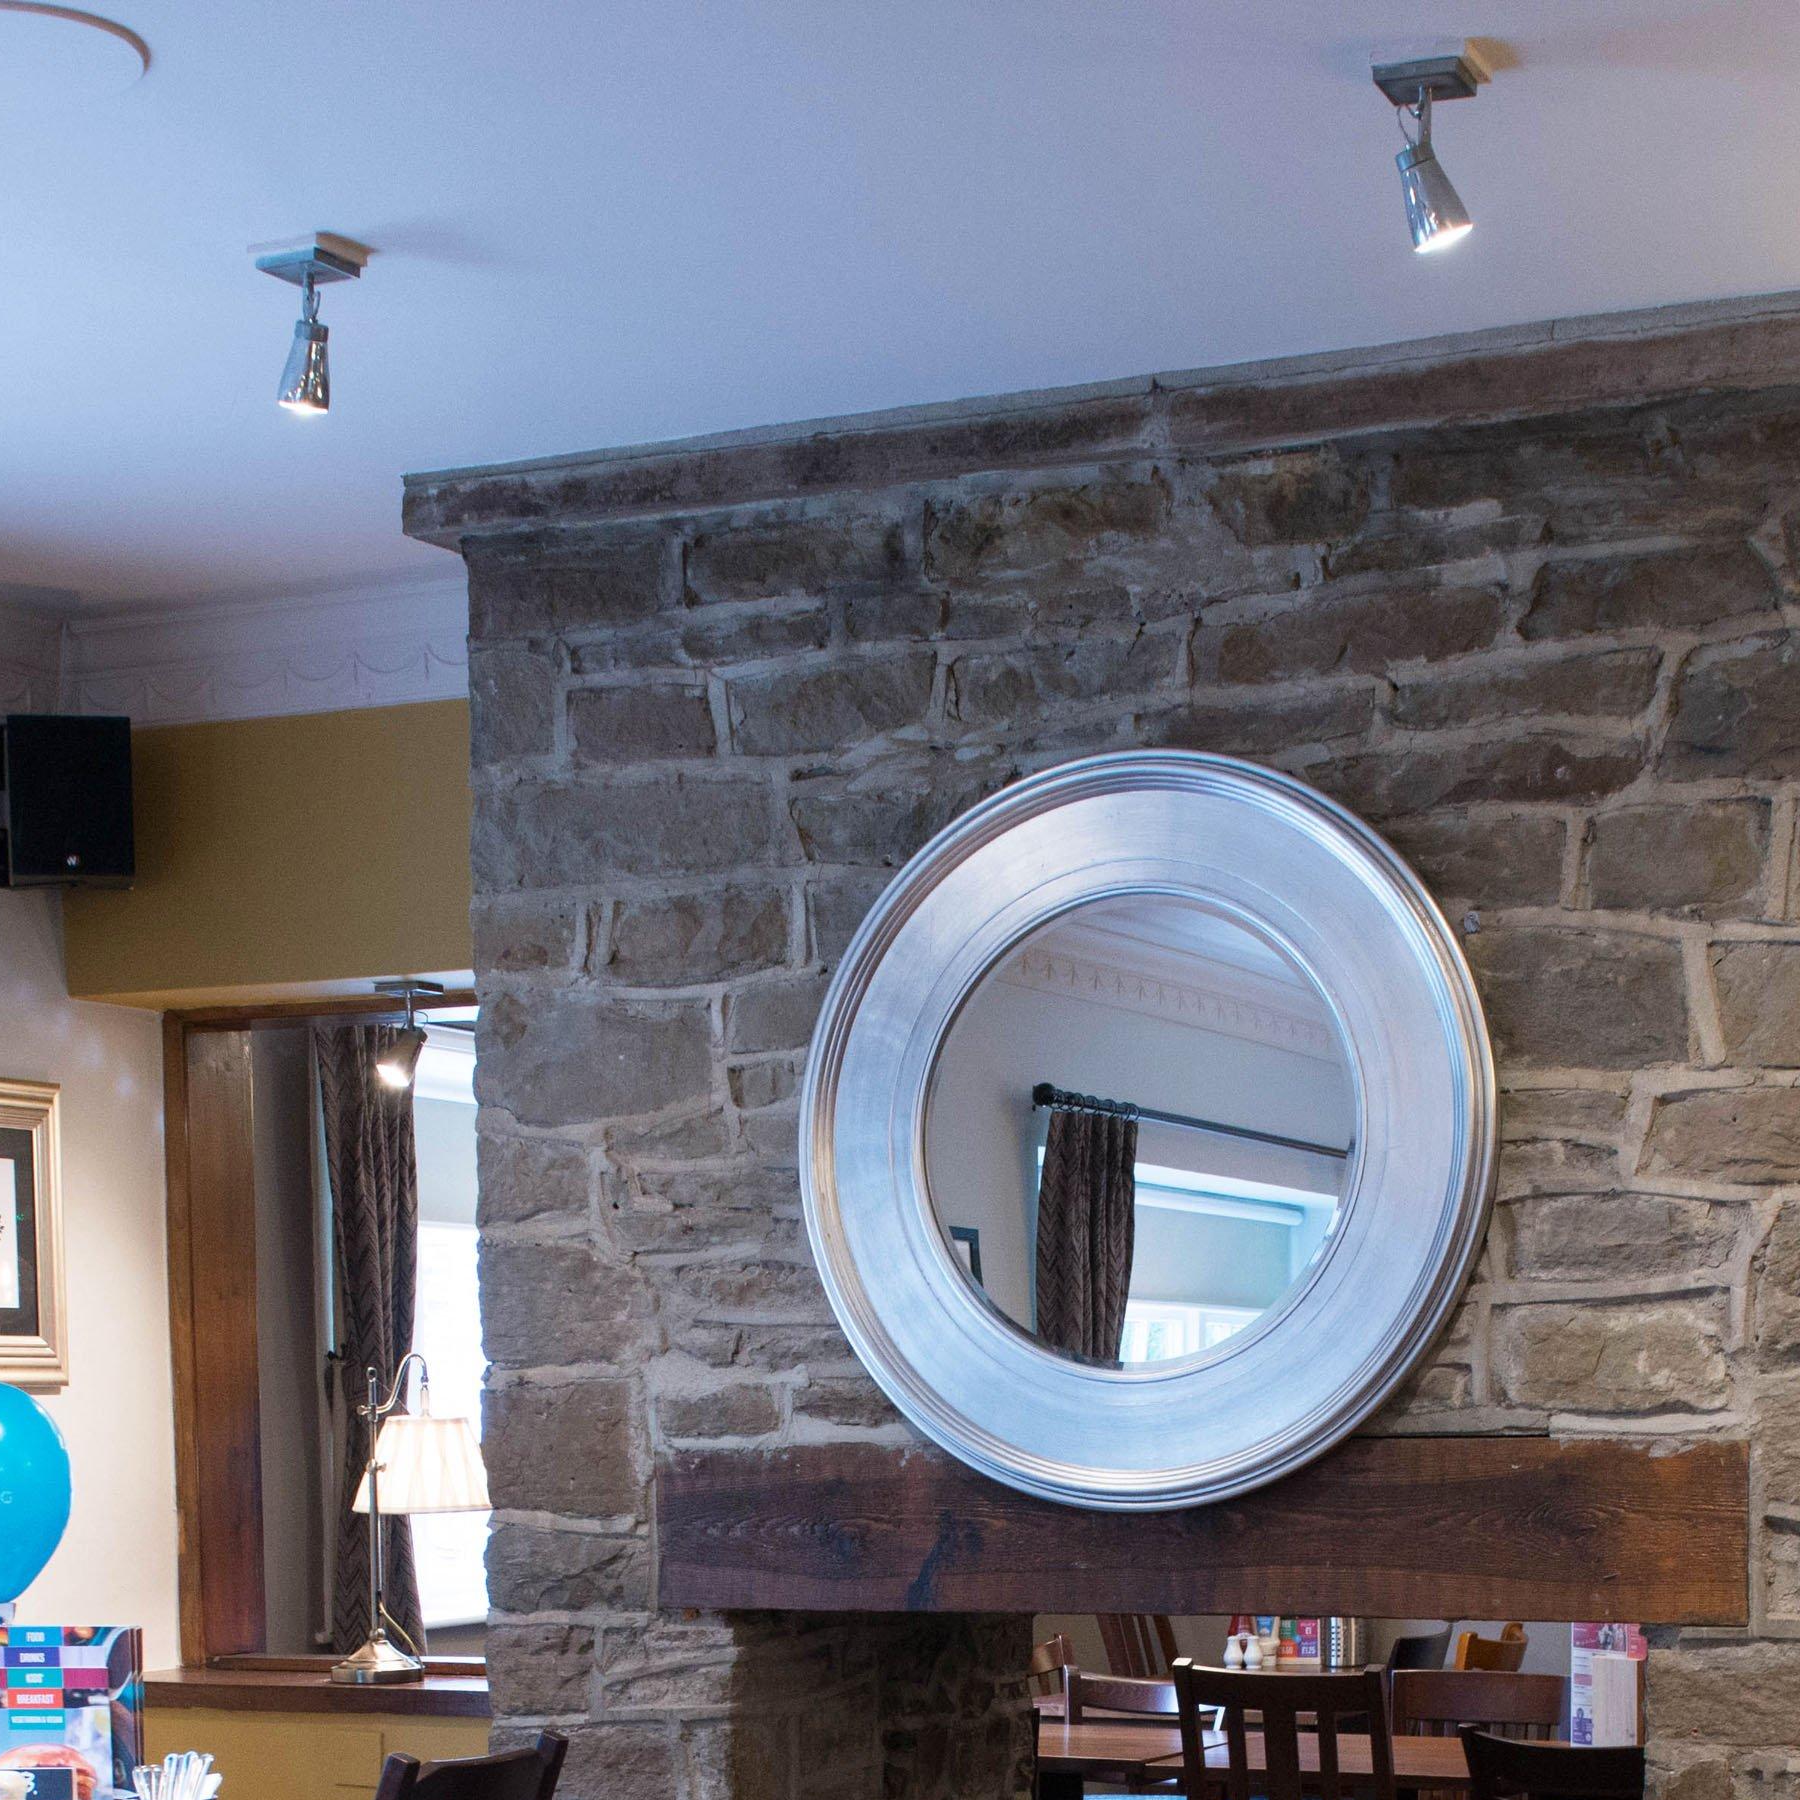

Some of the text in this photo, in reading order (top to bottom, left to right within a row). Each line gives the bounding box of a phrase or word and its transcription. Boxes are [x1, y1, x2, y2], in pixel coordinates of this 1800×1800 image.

[25, 1631, 45, 1643] FOOD
[19, 1652, 45, 1664] DRINKS
[16, 1694, 54, 1705] BREAKFAST
